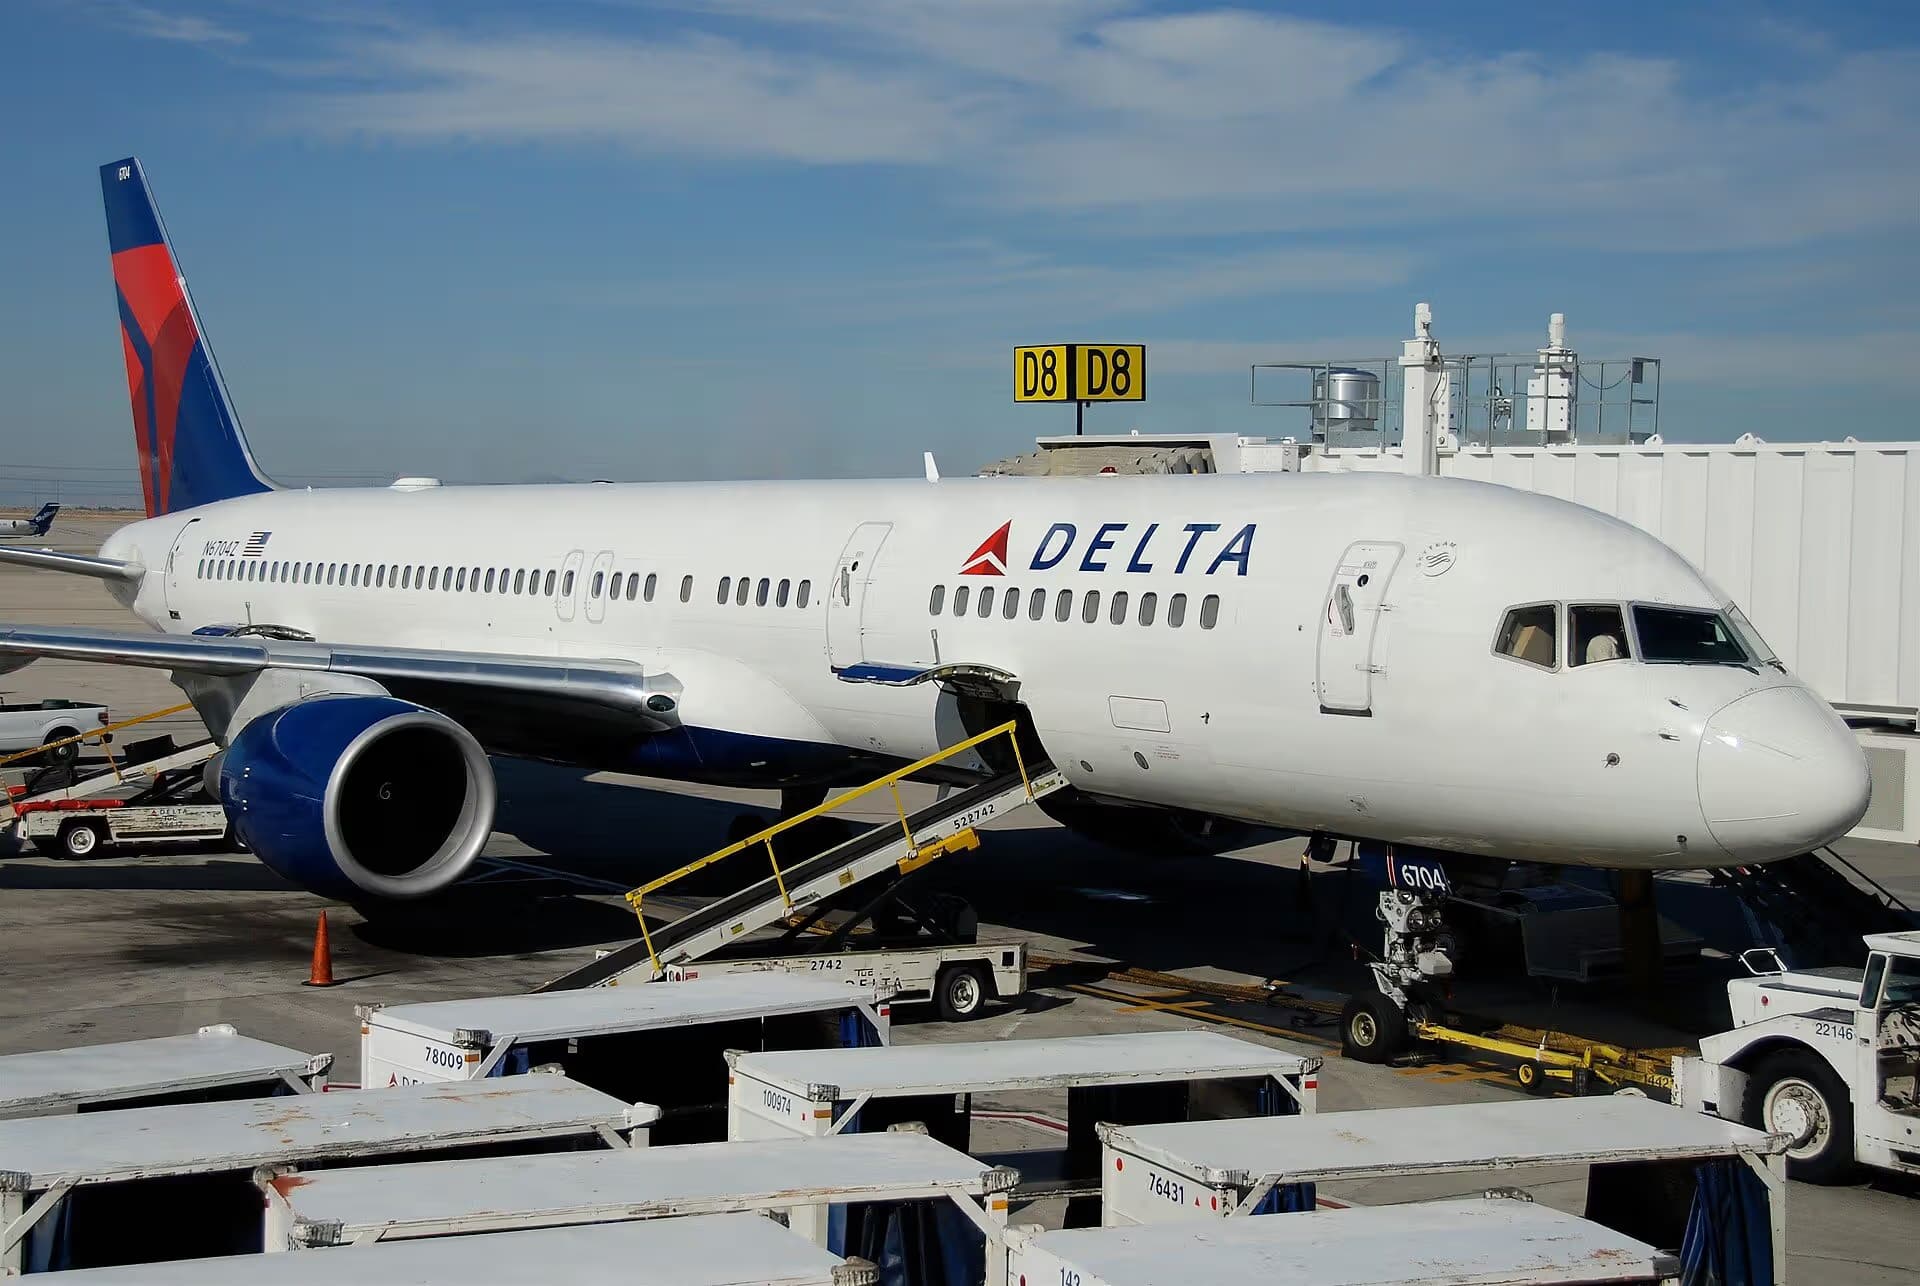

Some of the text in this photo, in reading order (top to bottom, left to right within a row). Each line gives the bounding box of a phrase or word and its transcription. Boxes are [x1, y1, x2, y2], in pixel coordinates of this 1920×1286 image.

[1023, 350, 1057, 396] D8
[1087, 348, 1131, 396] D8
[202, 540, 240, 556] N6704Z
[1029, 522, 1257, 576] DELTA
[953, 804, 995, 829] 522742
[1401, 864, 1446, 891] 6704
[810, 959, 842, 971] 2742
[1815, 1022, 1853, 1040] 22146
[425, 1046, 463, 1070] 78009
[763, 1088, 791, 1116] 100974
[1149, 1172, 1185, 1205] 76431
